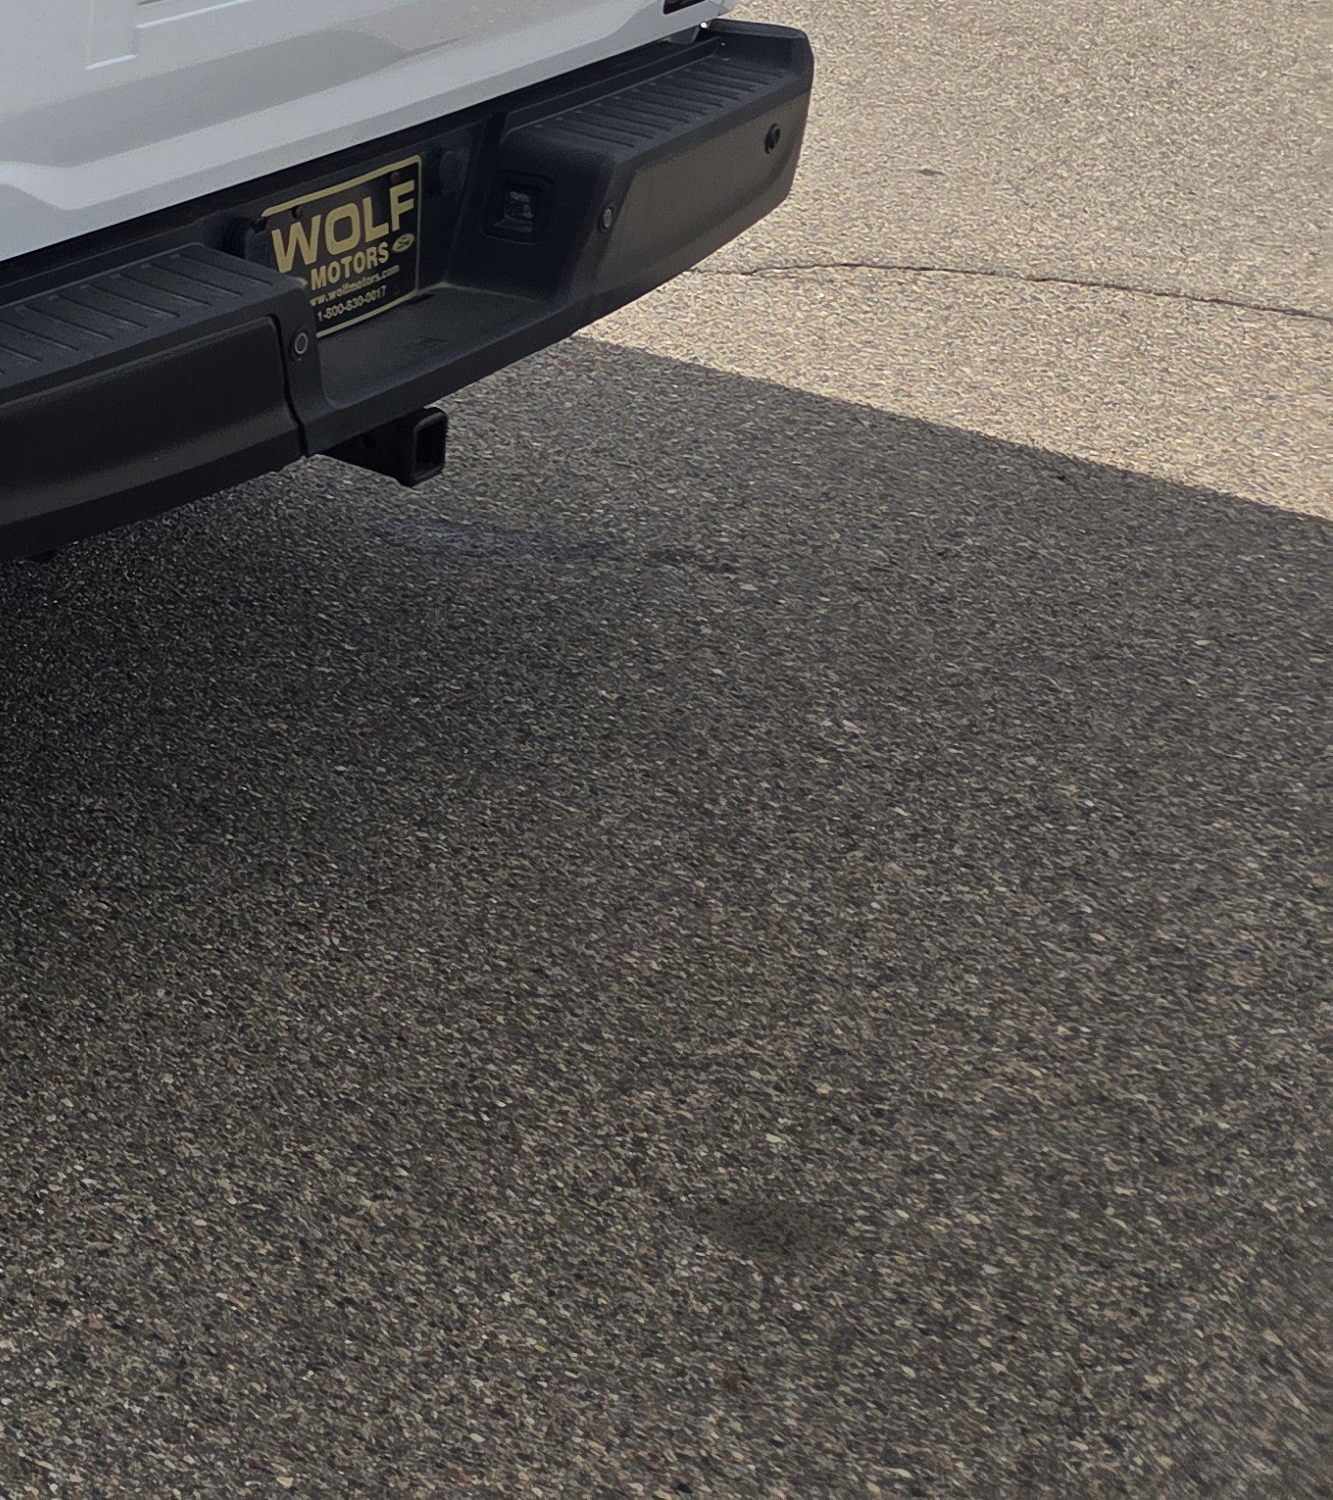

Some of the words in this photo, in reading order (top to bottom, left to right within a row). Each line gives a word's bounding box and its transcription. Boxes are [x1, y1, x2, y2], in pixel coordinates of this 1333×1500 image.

[271, 179, 415, 273] WOLF
[309, 264, 400, 307] ww.wolfmotors.com
[310, 241, 390, 291] MOTORS
